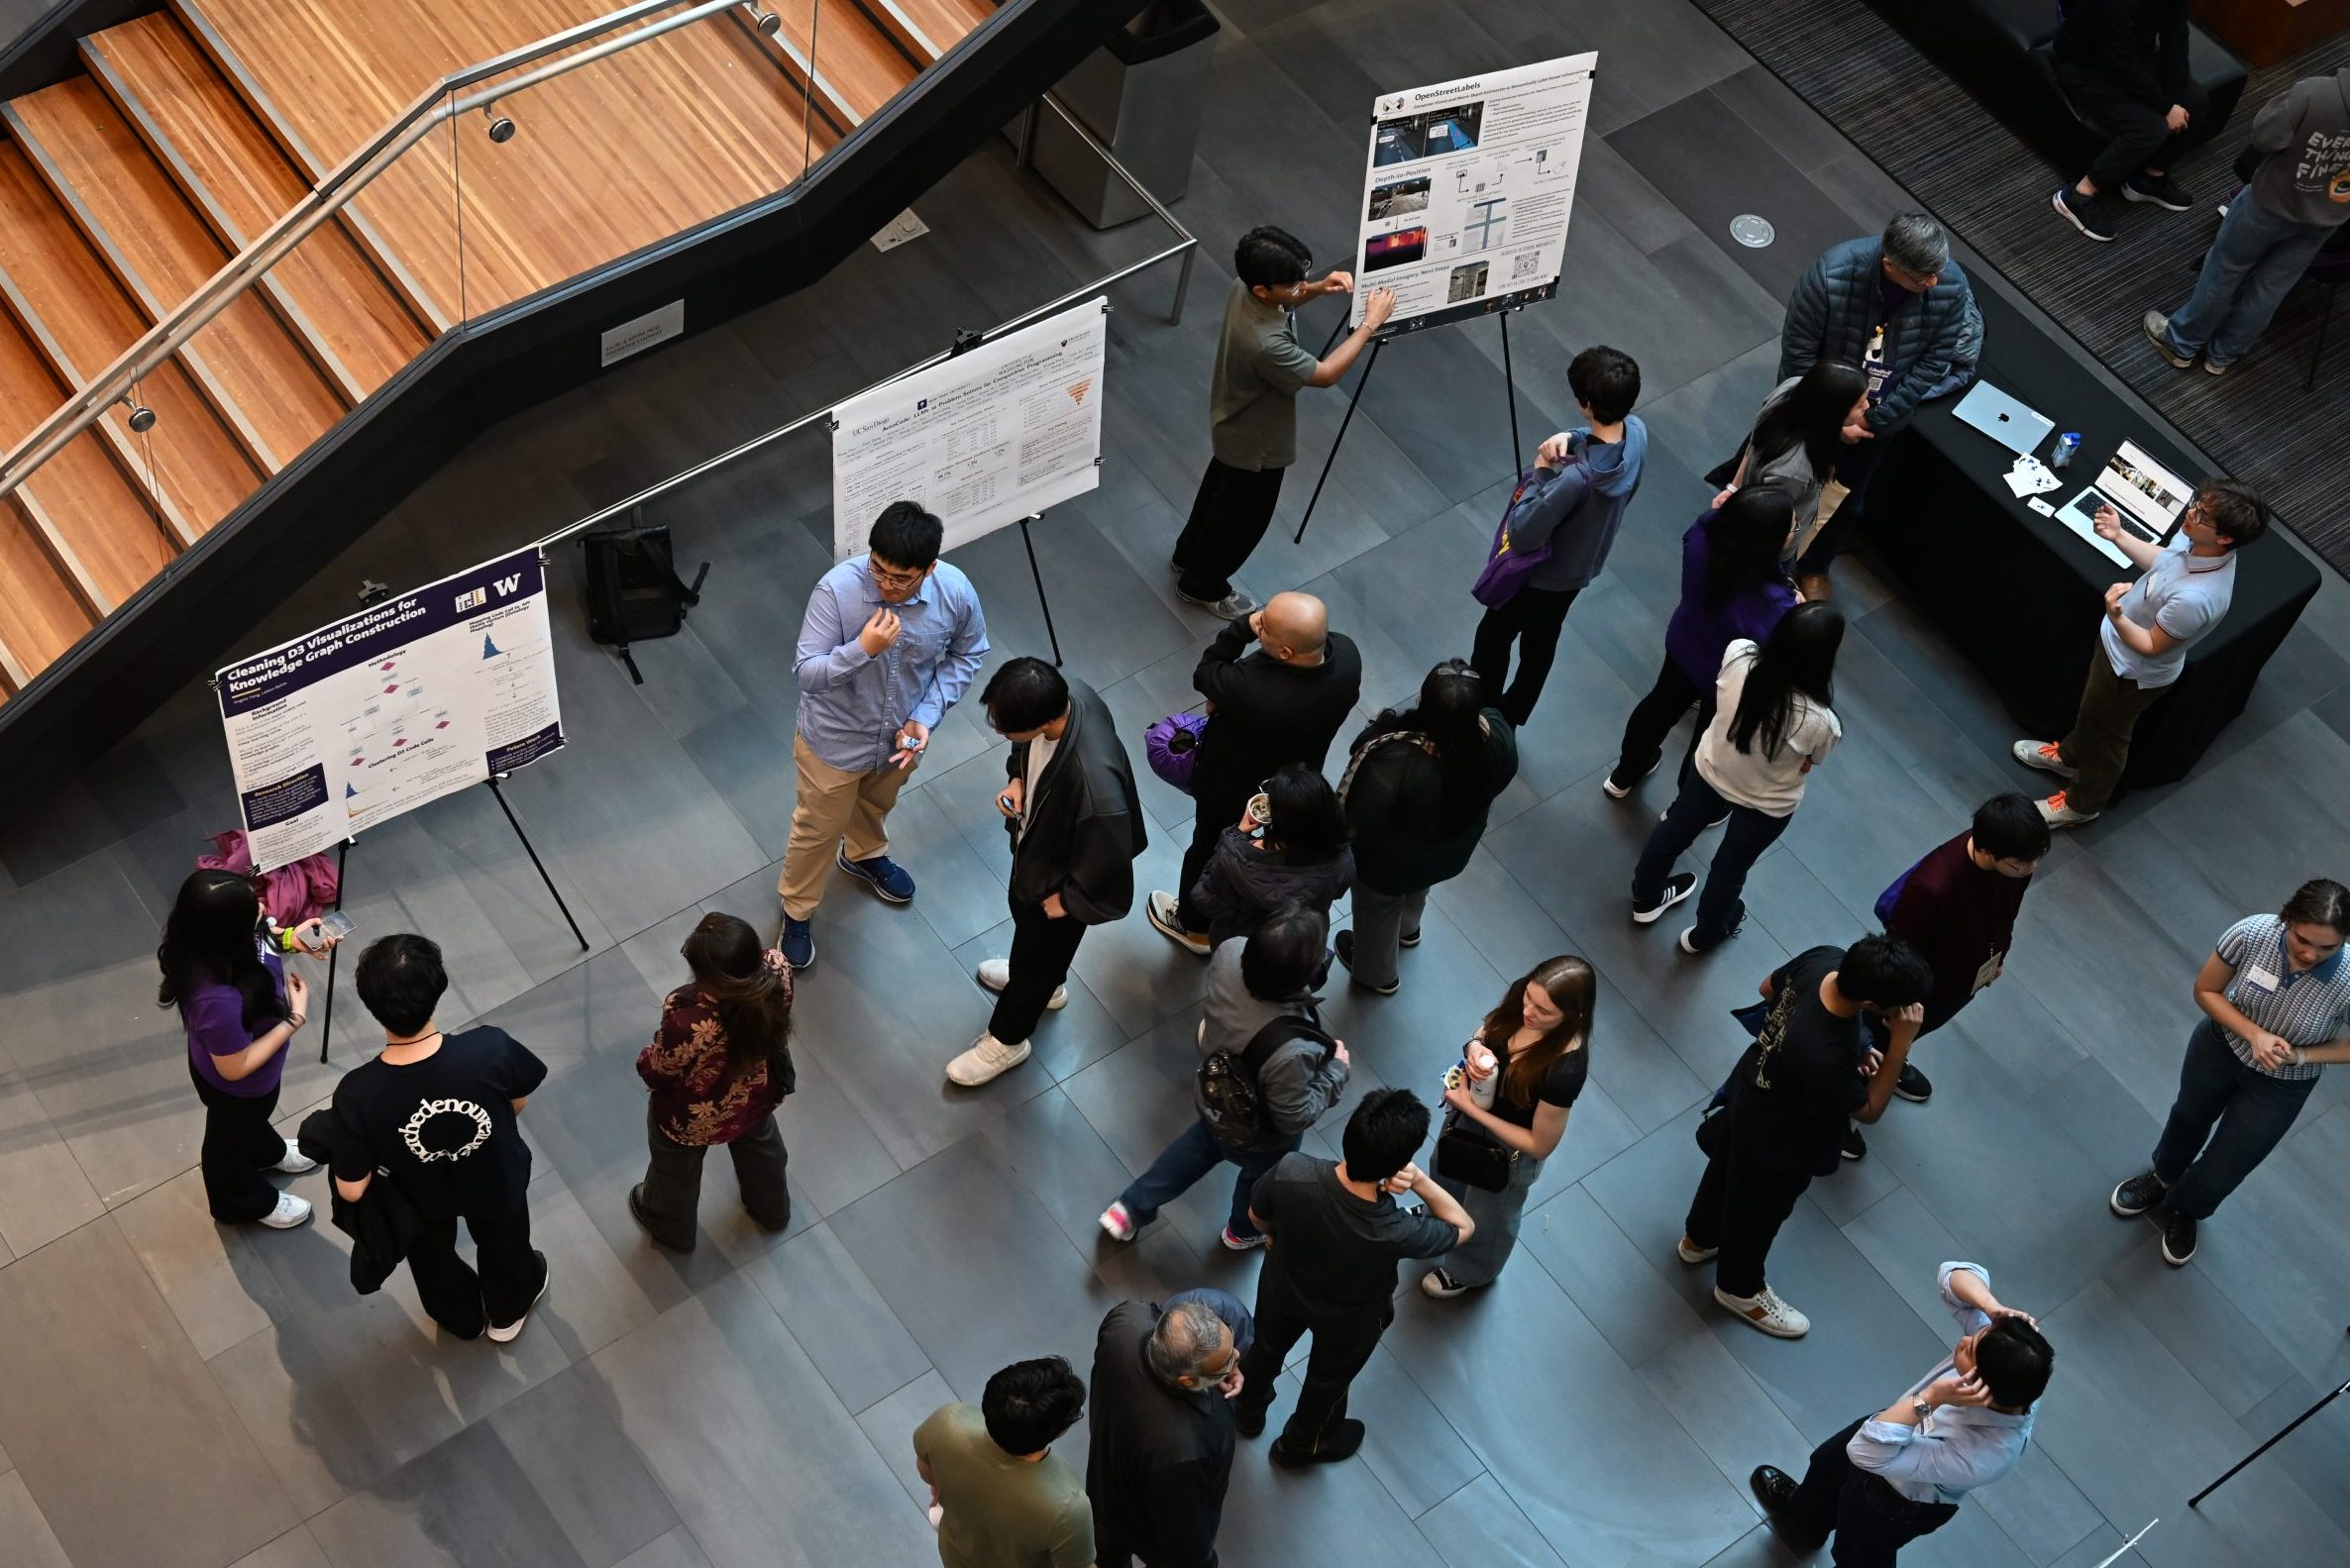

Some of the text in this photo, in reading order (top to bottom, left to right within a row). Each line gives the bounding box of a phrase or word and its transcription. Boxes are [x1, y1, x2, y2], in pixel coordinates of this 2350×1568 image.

[1414, 80, 1481, 101] OpenStreetLabels
[1374, 166, 1431, 184] Depth-to-Position
[938, 394, 960, 407] Problem
[993, 366, 1024, 383] Competitive
[1026, 351, 1062, 369] Programming
[852, 415, 889, 436] UC San Diego
[493, 573, 521, 597] W
[228, 597, 417, 680] Cleaning D3 Visualizations for
[229, 606, 426, 692] Knowledge Graph Construction
[368, 649, 405, 668] Methodology
[252, 698, 286, 715] Background
[252, 704, 286, 720] Information
[506, 734, 541, 752] Future Work
[368, 753, 395, 769] Clustering
[405, 742, 419, 752] Code
[255, 773, 308, 796] Research Direction
[284, 817, 298, 826] Goal
